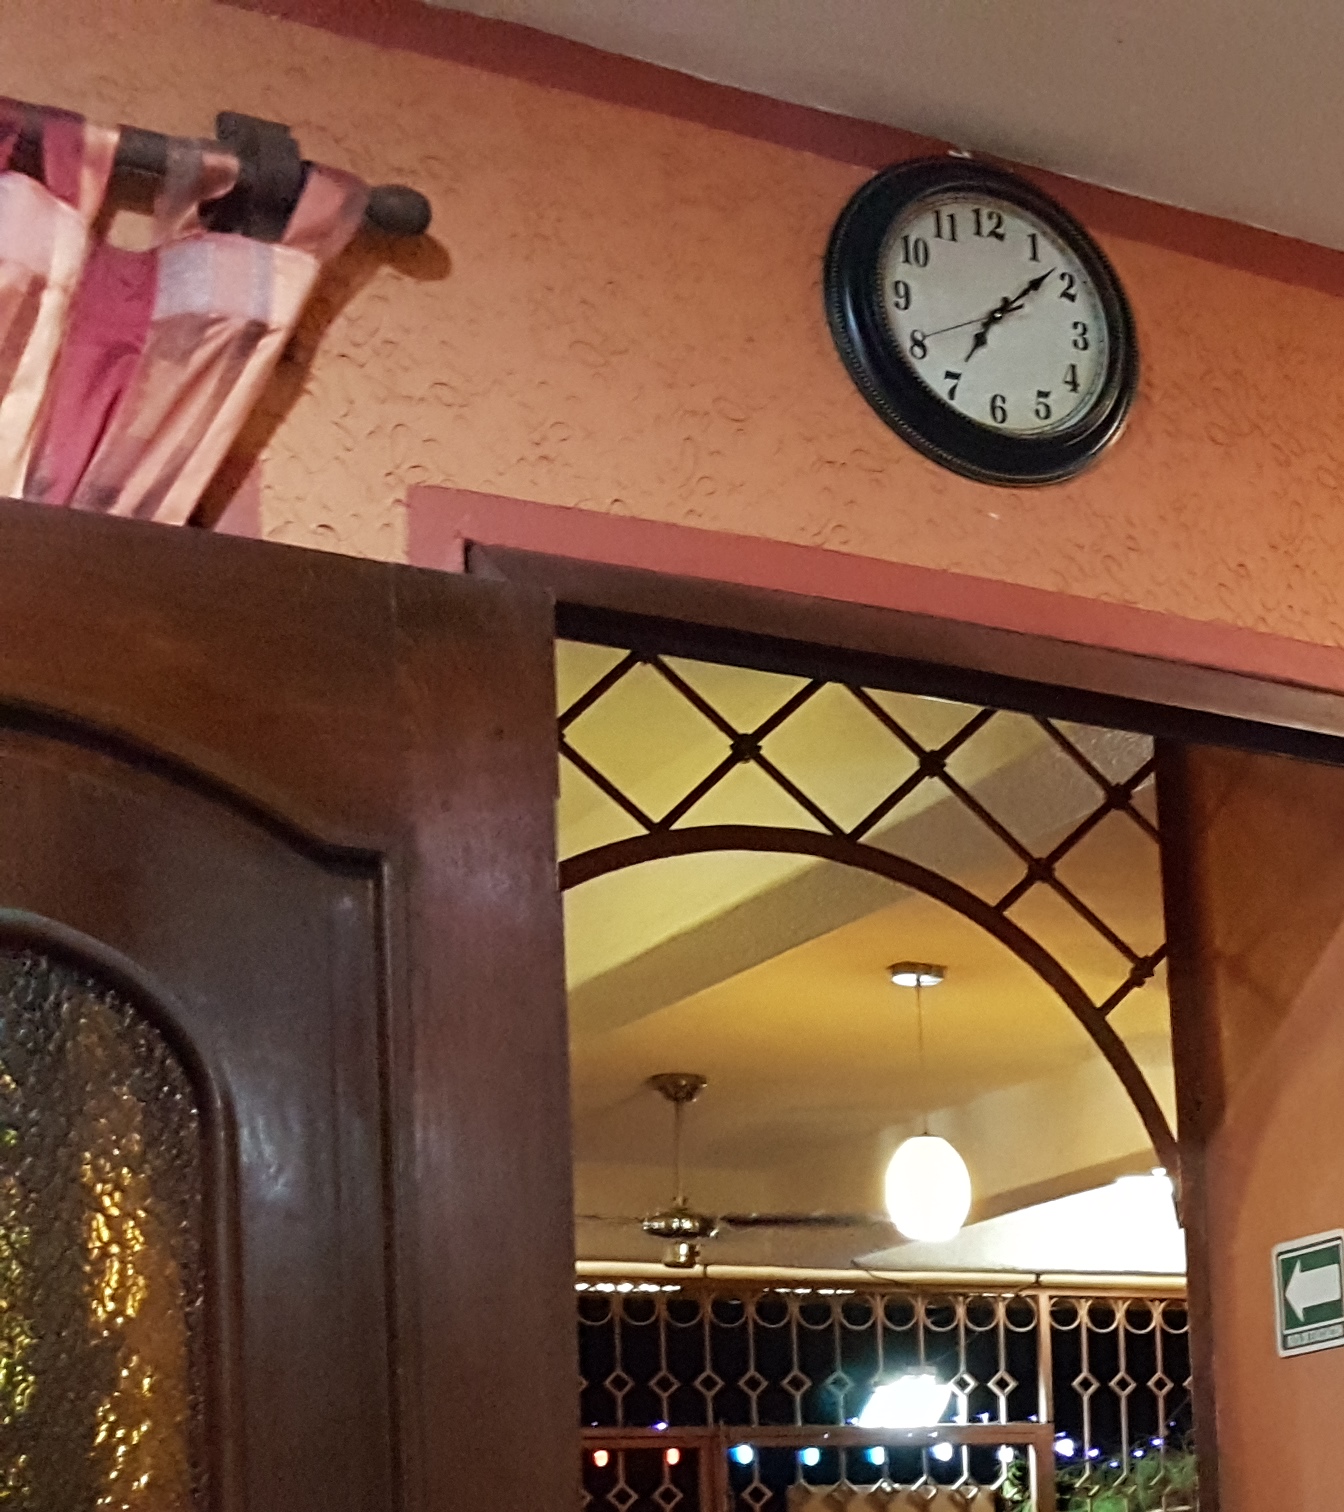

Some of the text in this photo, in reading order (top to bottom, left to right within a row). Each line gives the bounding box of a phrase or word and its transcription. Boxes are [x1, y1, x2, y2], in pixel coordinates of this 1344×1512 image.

[934, 210, 958, 242] 11
[971, 207, 1006, 241] 12
[902, 235, 929, 267] 10
[1027, 233, 1041, 262] 1
[893, 280, 912, 311] 9
[1059, 272, 1078, 303] 2
[910, 329, 927, 360] 8
[1072, 321, 1089, 352] 3
[944, 371, 962, 402] 7
[1063, 363, 1080, 394] 4
[990, 394, 1007, 424] 6
[1034, 390, 1052, 420] 5
